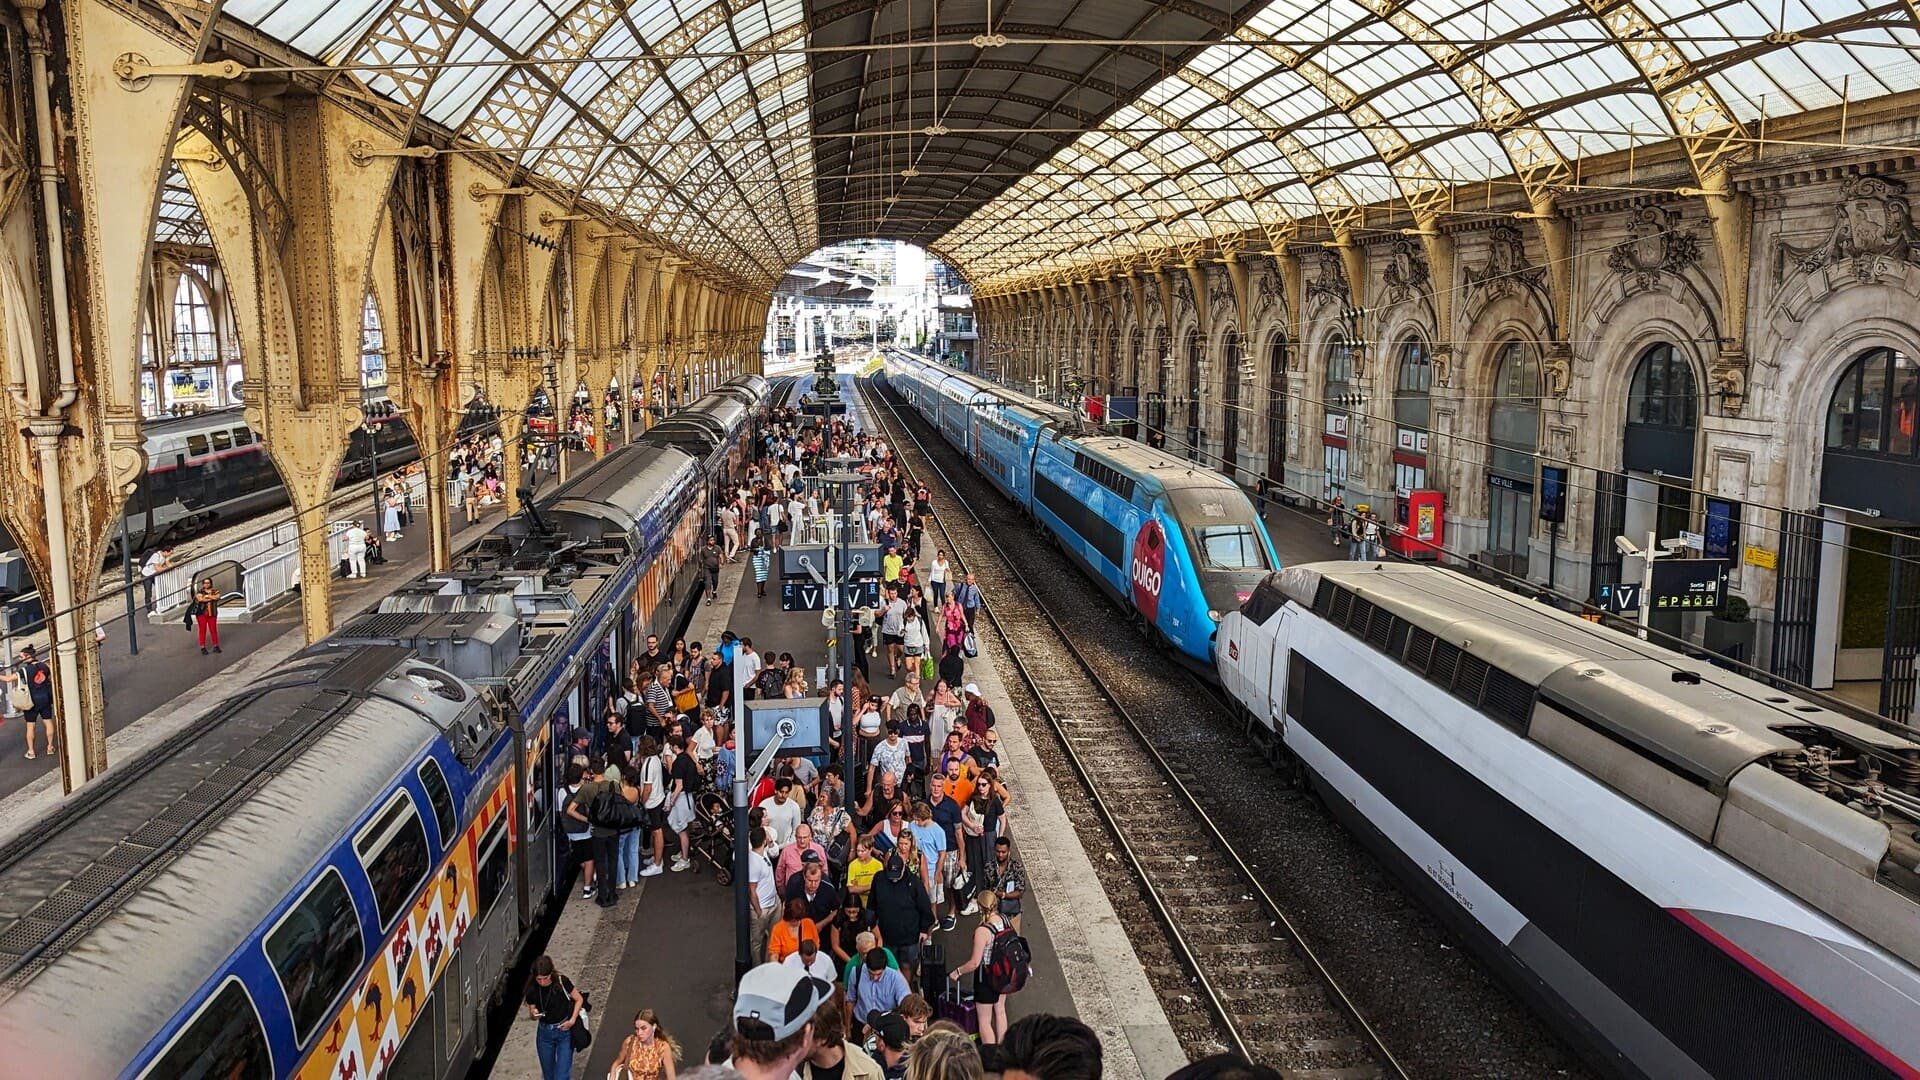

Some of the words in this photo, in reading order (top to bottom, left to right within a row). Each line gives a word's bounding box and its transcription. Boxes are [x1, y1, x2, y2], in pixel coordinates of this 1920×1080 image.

[1501, 478, 1513, 488] VILLE
[801, 589, 818, 609] V
[848, 588, 861, 608] V
[1616, 589, 1633, 609] V
[1671, 596, 1679, 606] P
